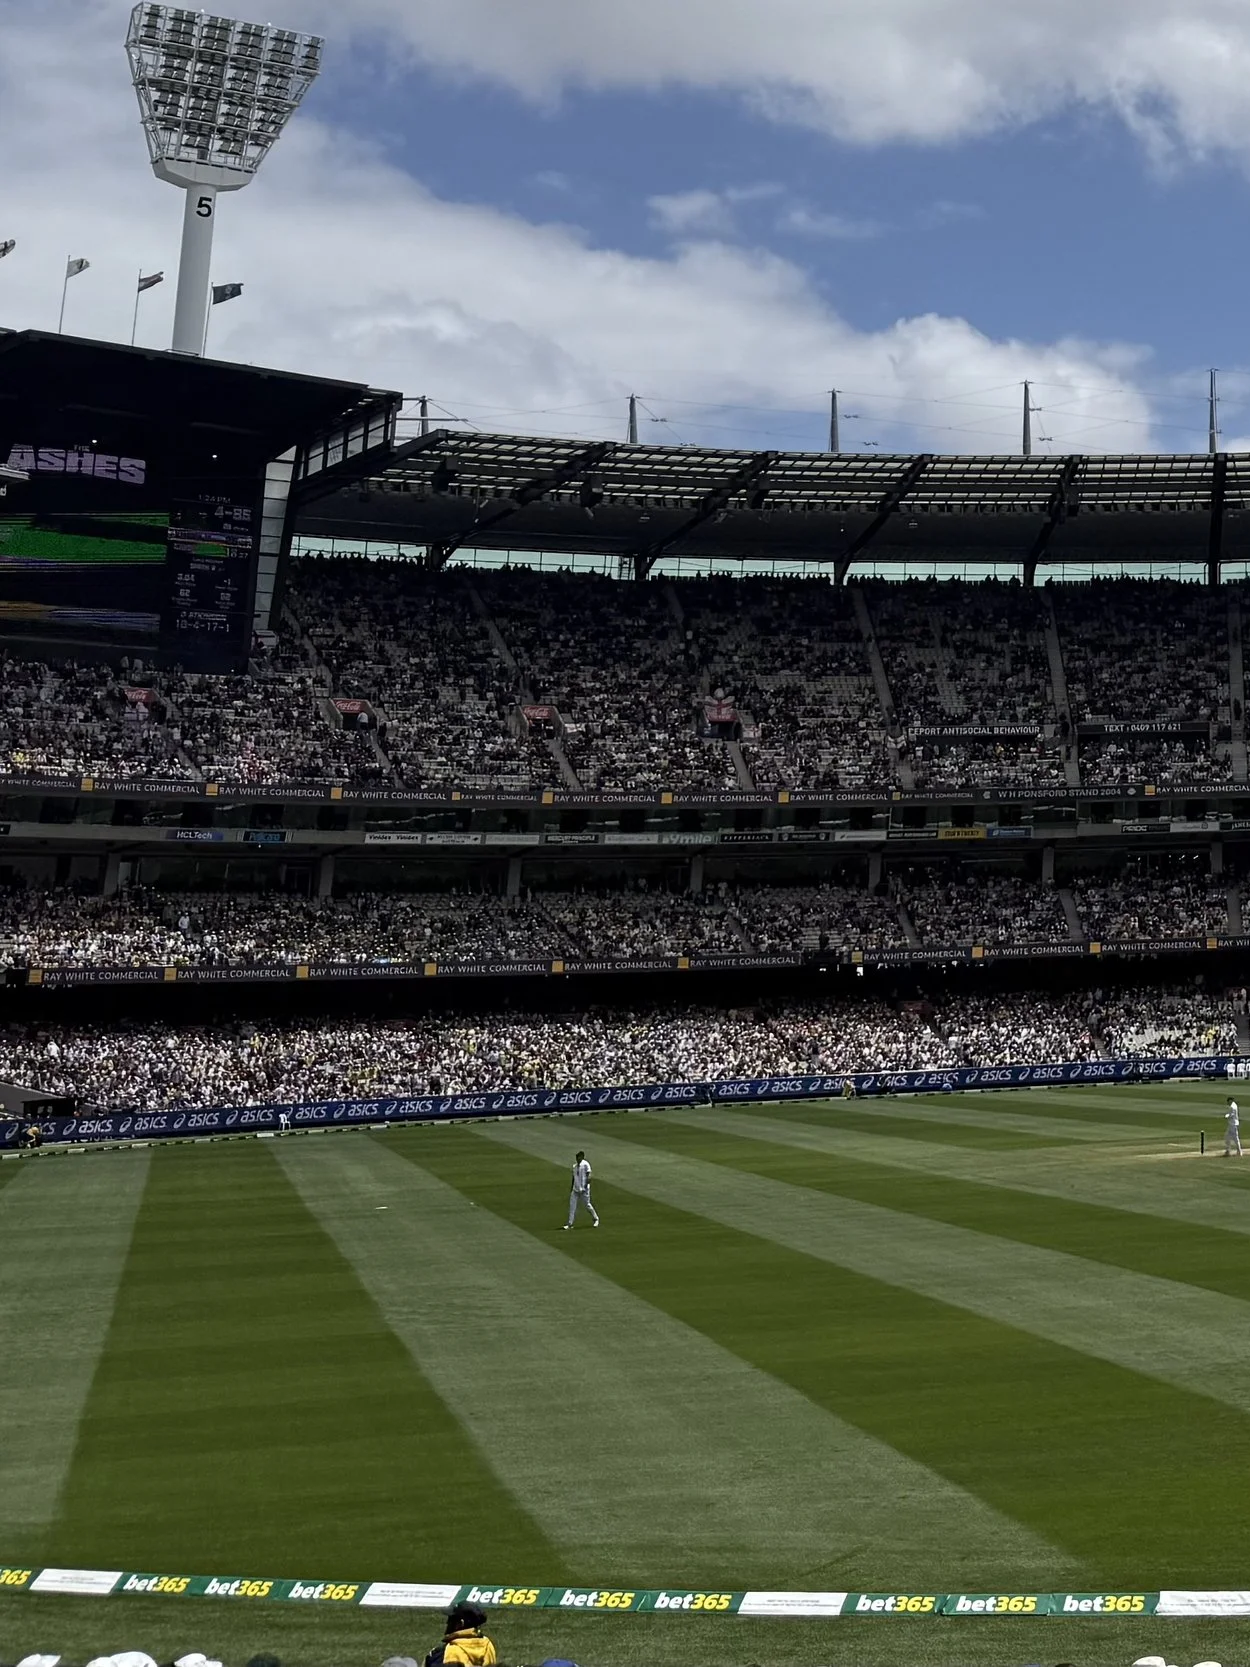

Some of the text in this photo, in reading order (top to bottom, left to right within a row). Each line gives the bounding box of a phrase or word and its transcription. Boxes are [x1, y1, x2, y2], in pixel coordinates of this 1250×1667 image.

[196, 196, 213, 218] 5
[7, 444, 146, 485] ASHES
[942, 727, 993, 736] ANTISOCIAL
[994, 726, 1040, 735] BEHAVIOUR
[1104, 724, 1125, 732] TEXT
[94, 782, 200, 793] RAY WHITE COMMERCIAL
[219, 787, 325, 797] RAY WHITE COMMERCIAL
[342, 790, 447, 800] RAY WHITE COMMERCIAL
[790, 792, 888, 801] RAY WHITE COMMERCIAL
[1018, 790, 1067, 798] PONSFORD
[1069, 788, 1098, 797] STAND
[1100, 788, 1122, 796] 2004
[674, 794, 773, 803] RAY WHITE COMMERCIAL
[176, 830, 212, 840] HCLTech
[1102, 941, 1202, 951] RAY WHITE COMMERCIAL
[1218, 938, 1233, 947] RAY
[864, 950, 966, 960] RAY WHITE COMMERCIAL
[985, 945, 1084, 956] RAY WHITE COMMERCIAL
[564, 961, 672, 970] RAY WHITE COMMERCIAL
[690, 956, 796, 967] RAY WHITE COMMERCIAL
[177, 969, 291, 978] RAY WHITE COMMERCIAL
[310, 966, 419, 976] RAY WHITE COMMERCIAL
[438, 964, 546, 974] RAY WHITE COMMERCIAL
[44, 971, 159, 980] RAY WHITE COMMERCIAL
[122, 1574, 191, 1593] bet365
[204, 1578, 274, 1598] bet365
[288, 1582, 359, 1601] bet365
[466, 1586, 540, 1604] bet365
[559, 1590, 635, 1608] bet365
[654, 1592, 732, 1610] bet365
[855, 1595, 936, 1612] bet365
[956, 1596, 1038, 1612] bet365
[1063, 1596, 1145, 1612] bet365
